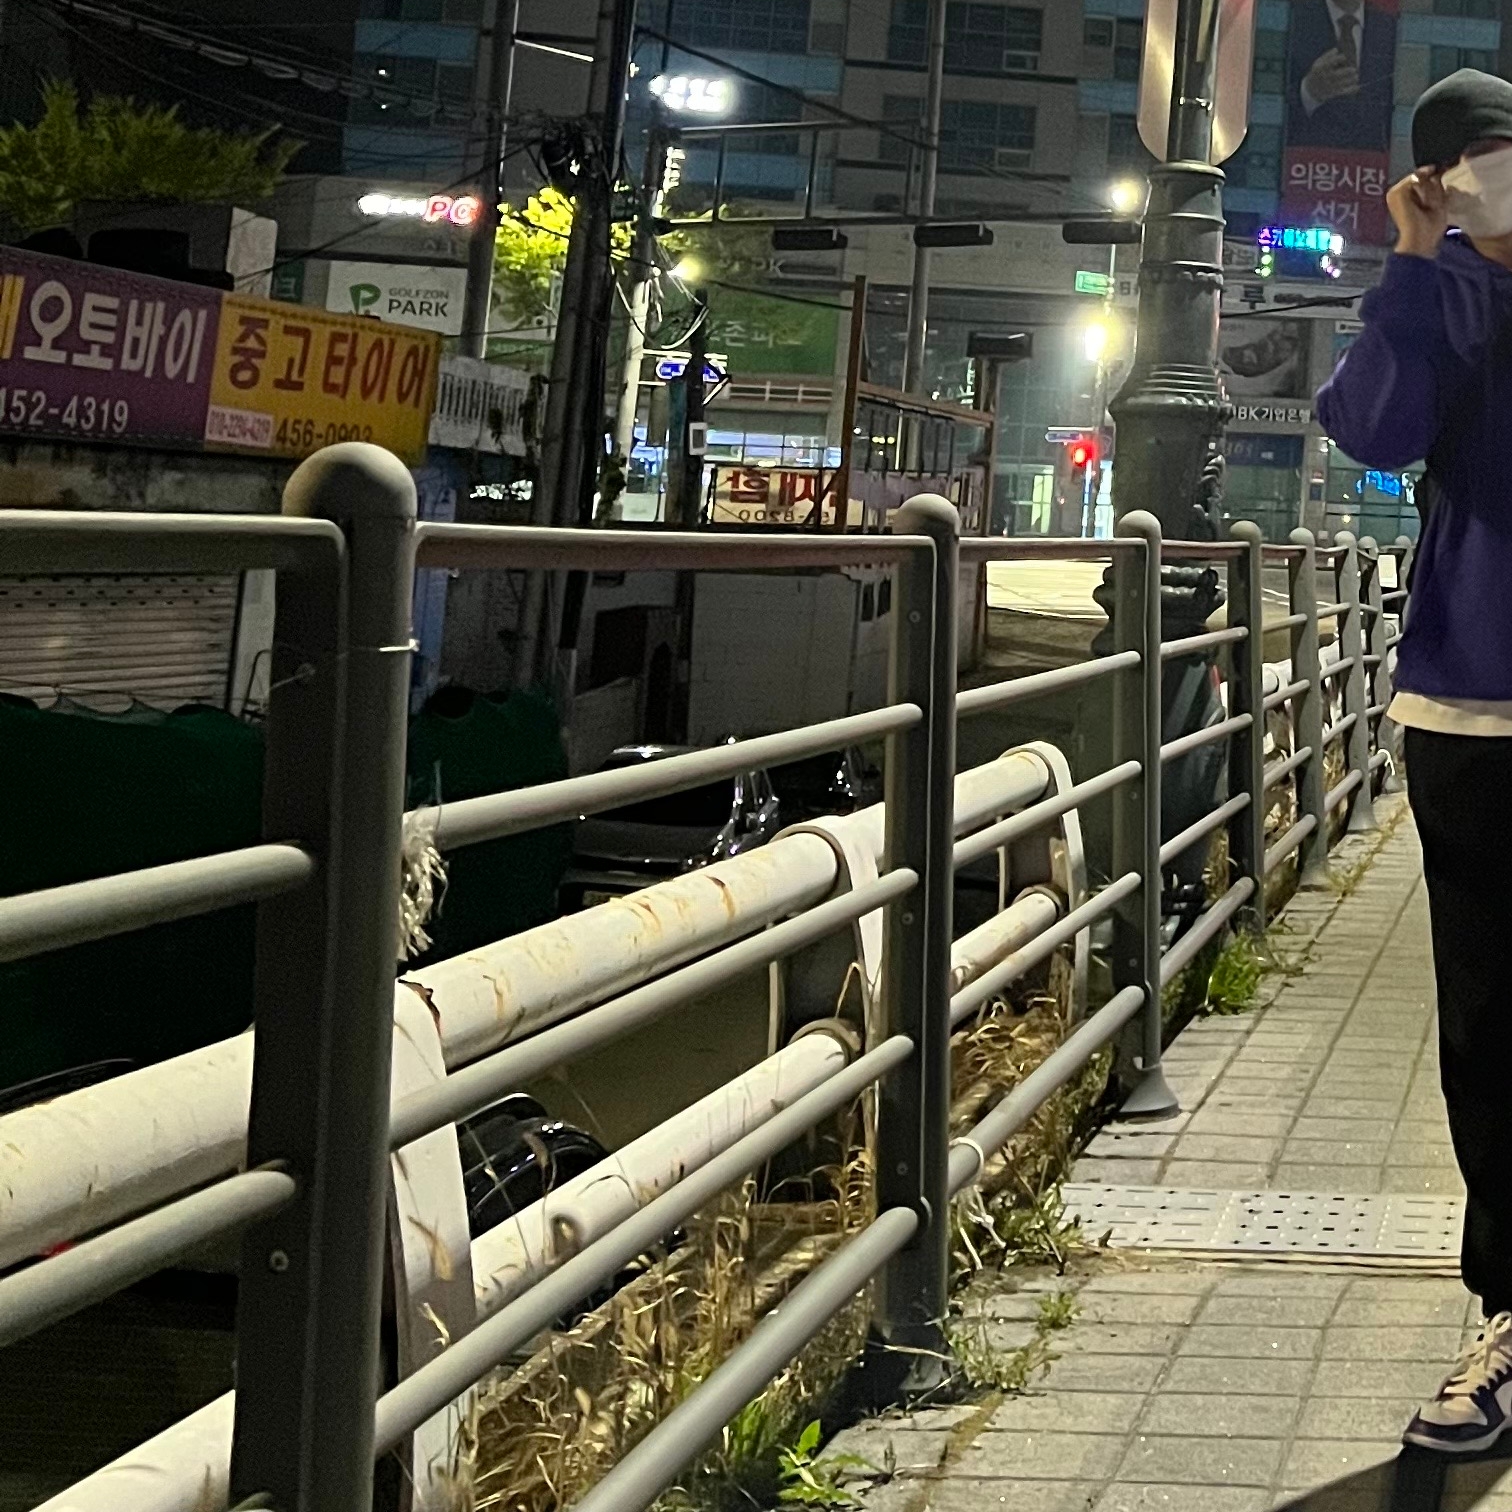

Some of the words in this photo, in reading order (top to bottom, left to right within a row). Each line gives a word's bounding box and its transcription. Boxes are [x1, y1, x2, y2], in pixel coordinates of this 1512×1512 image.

[1288, 161, 1386, 196] 의왕시장
[388, 288, 450, 300] GOLFZON
[388, 298, 449, 318] PARK
[23, 279, 208, 384] 오토바이
